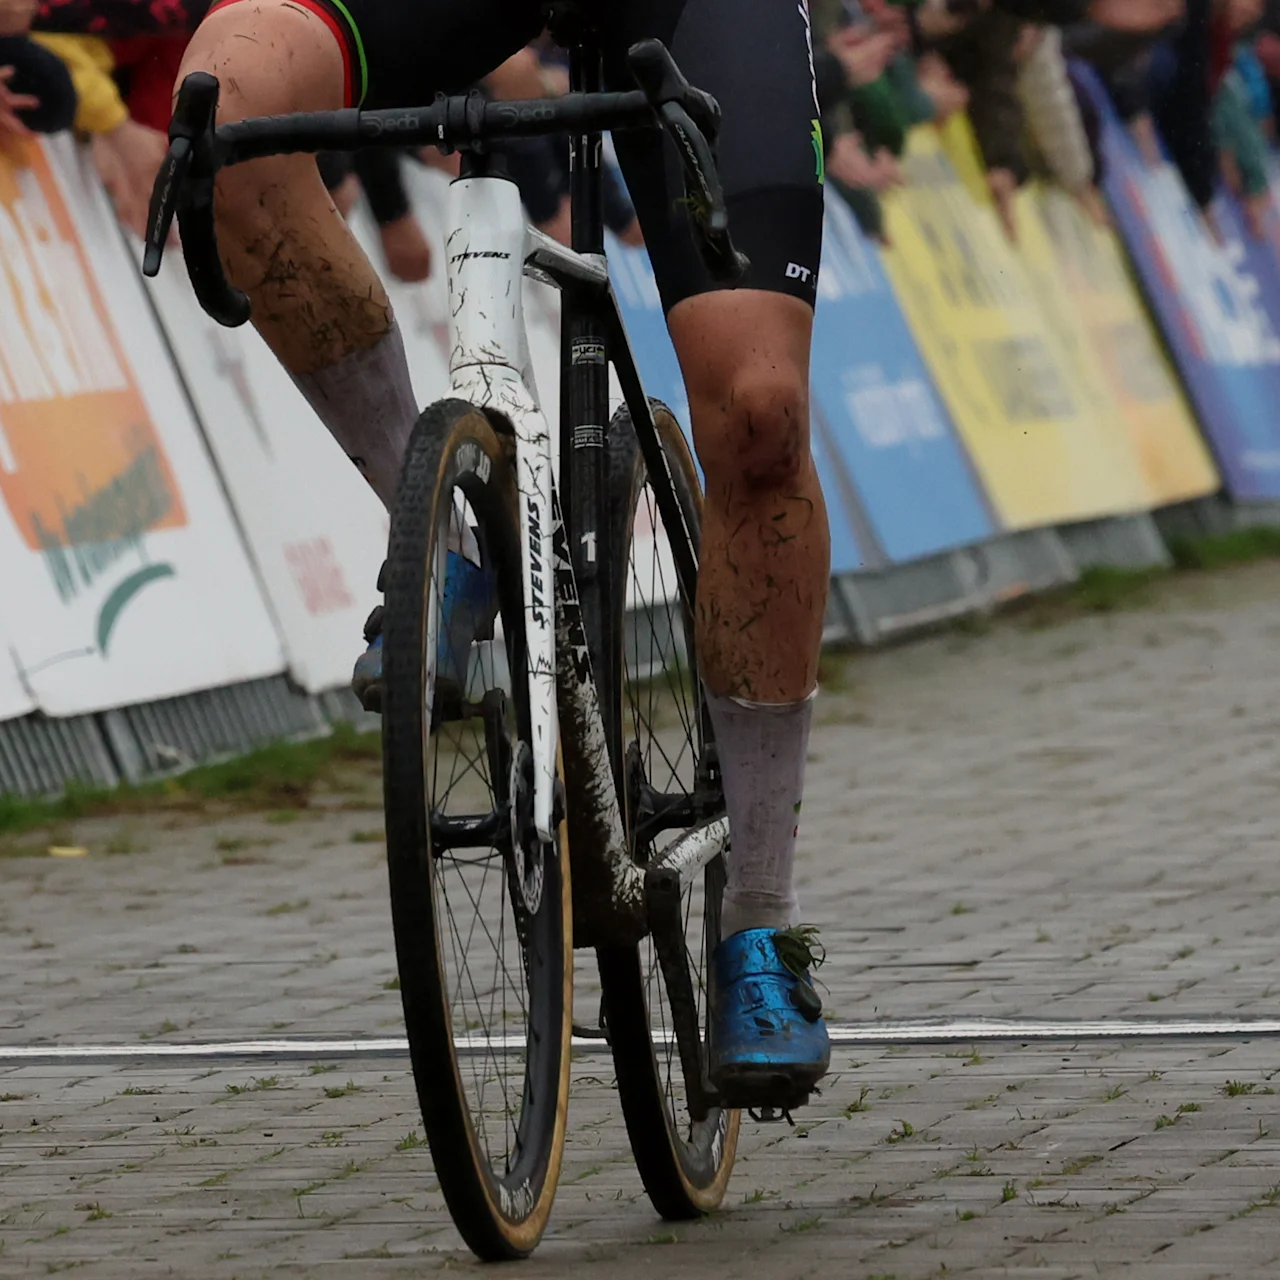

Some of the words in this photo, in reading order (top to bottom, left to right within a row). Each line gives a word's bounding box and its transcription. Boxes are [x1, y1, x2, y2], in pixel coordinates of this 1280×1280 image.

[450, 252, 511, 264] STEVENS
[785, 261, 811, 283] DT
[581, 531, 597, 562] 1
[527, 497, 544, 625] STEVENS
